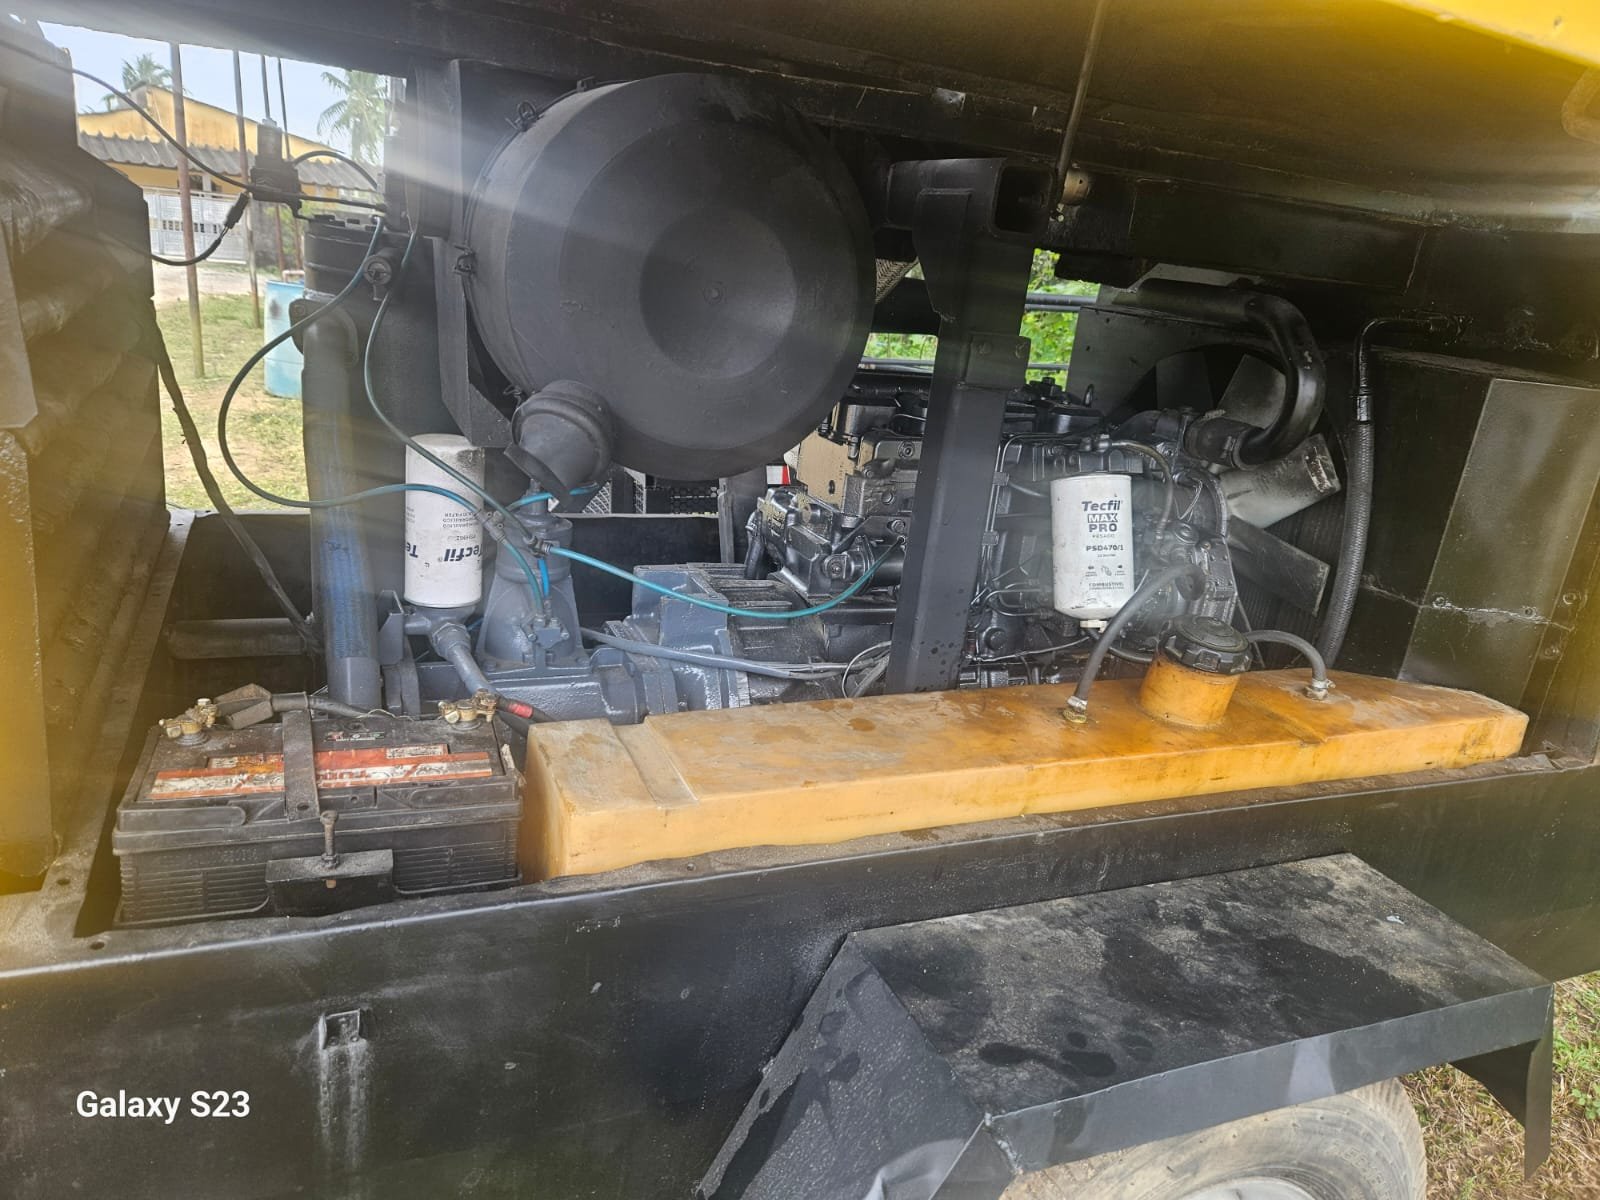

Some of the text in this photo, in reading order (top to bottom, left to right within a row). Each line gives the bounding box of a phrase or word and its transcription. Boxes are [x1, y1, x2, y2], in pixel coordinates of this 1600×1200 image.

[1081, 500, 1121, 511] Tecfil
[1088, 513, 1118, 523] MAX
[1088, 523, 1118, 532] PRO
[1086, 544, 1124, 552] PSD470/1
